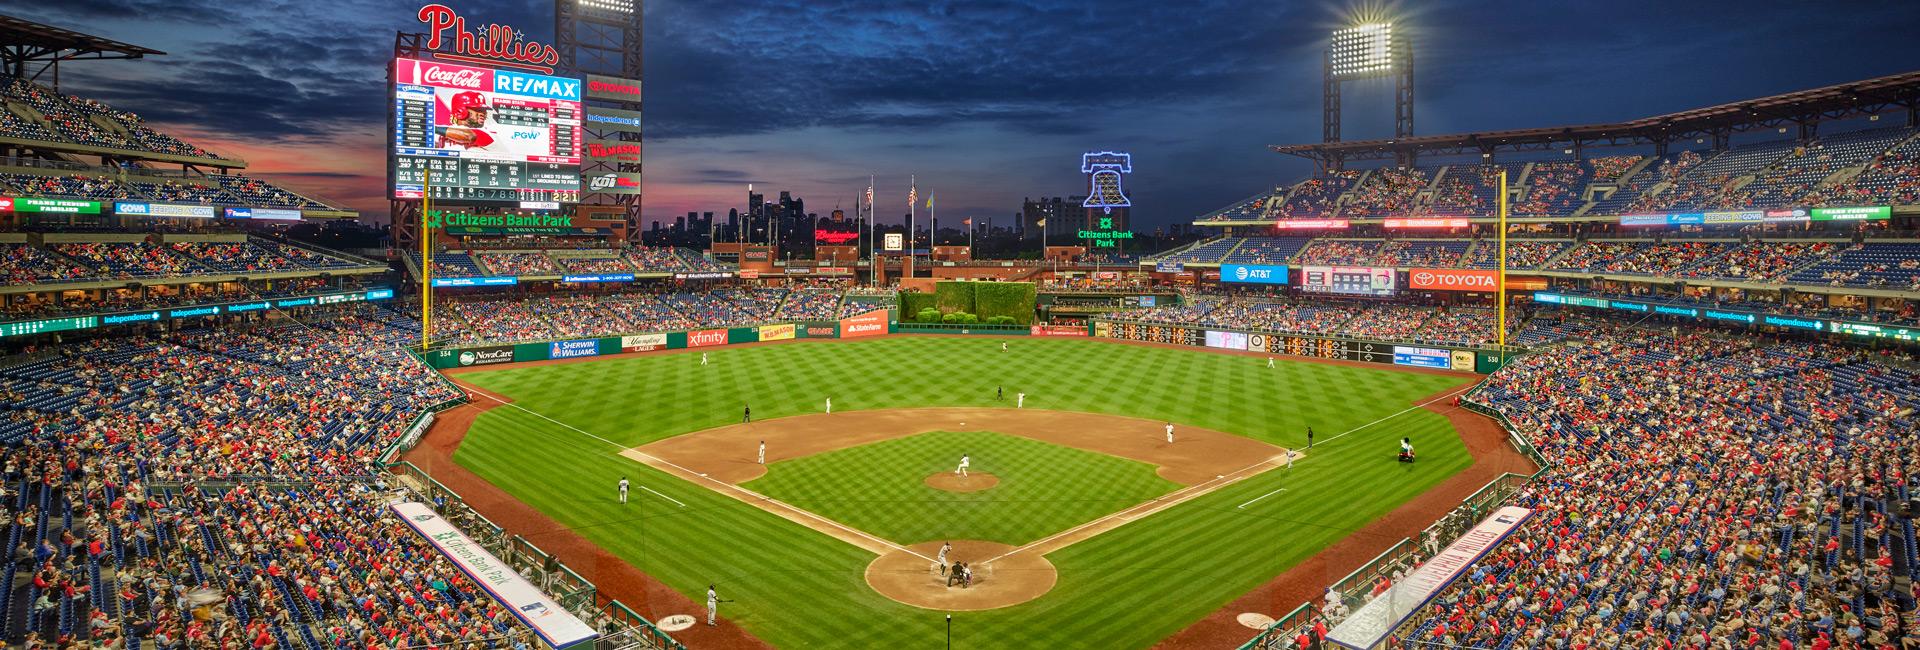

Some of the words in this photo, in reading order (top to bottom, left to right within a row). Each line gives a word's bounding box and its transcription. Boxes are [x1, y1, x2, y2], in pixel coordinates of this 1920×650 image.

[418, 5, 559, 65] Phillies
[424, 66, 484, 88] Coca-Cola
[497, 75, 576, 98] RE/MAX
[602, 83, 640, 95] TOYOTA
[515, 131, 537, 139] PGW
[553, 193, 559, 202] 2
[563, 194, 569, 202] 2
[572, 194, 577, 202] 1
[120, 204, 146, 213] GOYA
[445, 215, 504, 227] Citizens
[507, 215, 540, 227] Bank
[543, 216, 572, 228] Park
[1078, 230, 1111, 239] Citizens
[1113, 230, 1133, 239] Bank
[1096, 239, 1114, 247] Park
[1250, 269, 1272, 279] AT&T
[1437, 275, 1495, 286] TOYOTA
[228, 303, 265, 311] Independence
[1612, 302, 1642, 310] Independence
[1655, 306, 1691, 315] Independence
[170, 309, 213, 318] Independence
[1706, 311, 1747, 321] Independence
[104, 315, 152, 325] Independence
[1766, 317, 1813, 328] Independence
[690, 332, 725, 346] xfinity
[562, 341, 594, 350] SHERWIN
[475, 349, 513, 359] NovaCare
